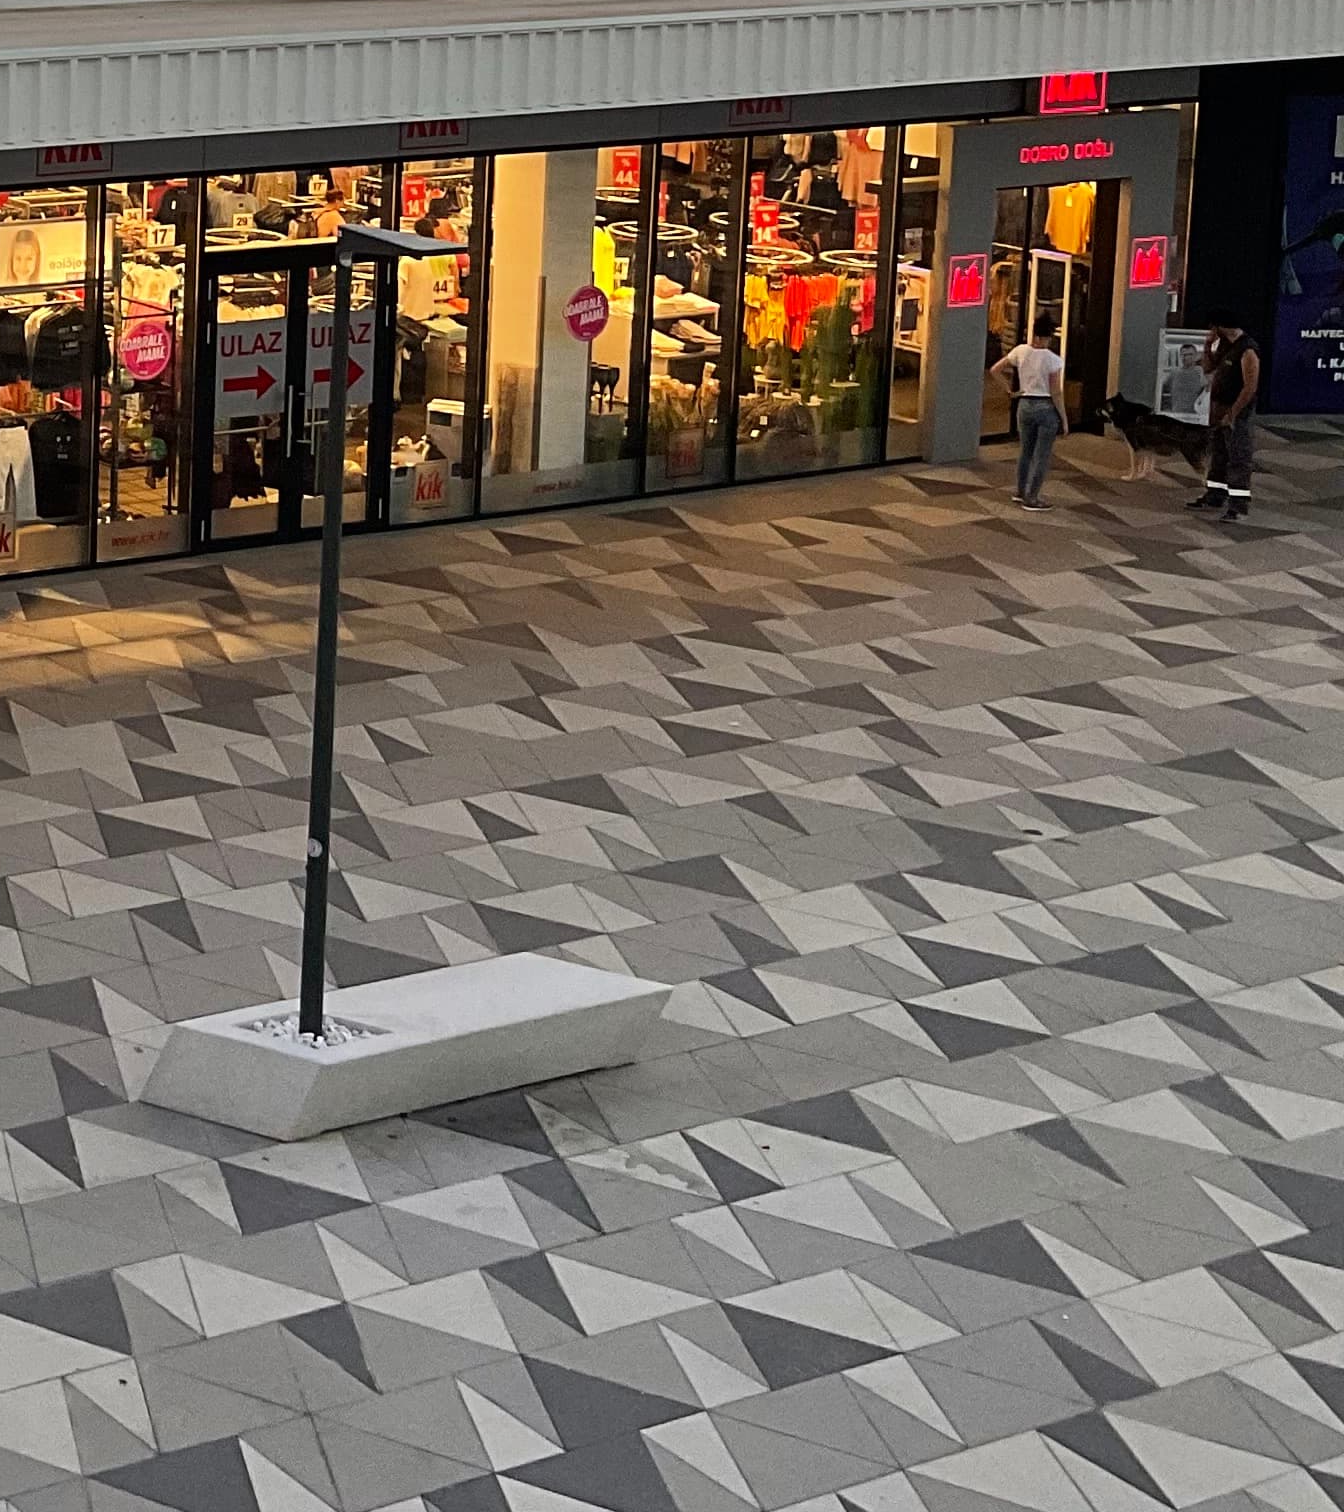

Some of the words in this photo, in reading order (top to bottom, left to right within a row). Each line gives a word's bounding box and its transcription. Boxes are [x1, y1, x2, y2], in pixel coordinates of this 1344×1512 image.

[151, 230, 168, 244] 17
[433, 279, 448, 293] 44
[221, 331, 283, 357] ULAZ
[415, 472, 444, 503] kik
